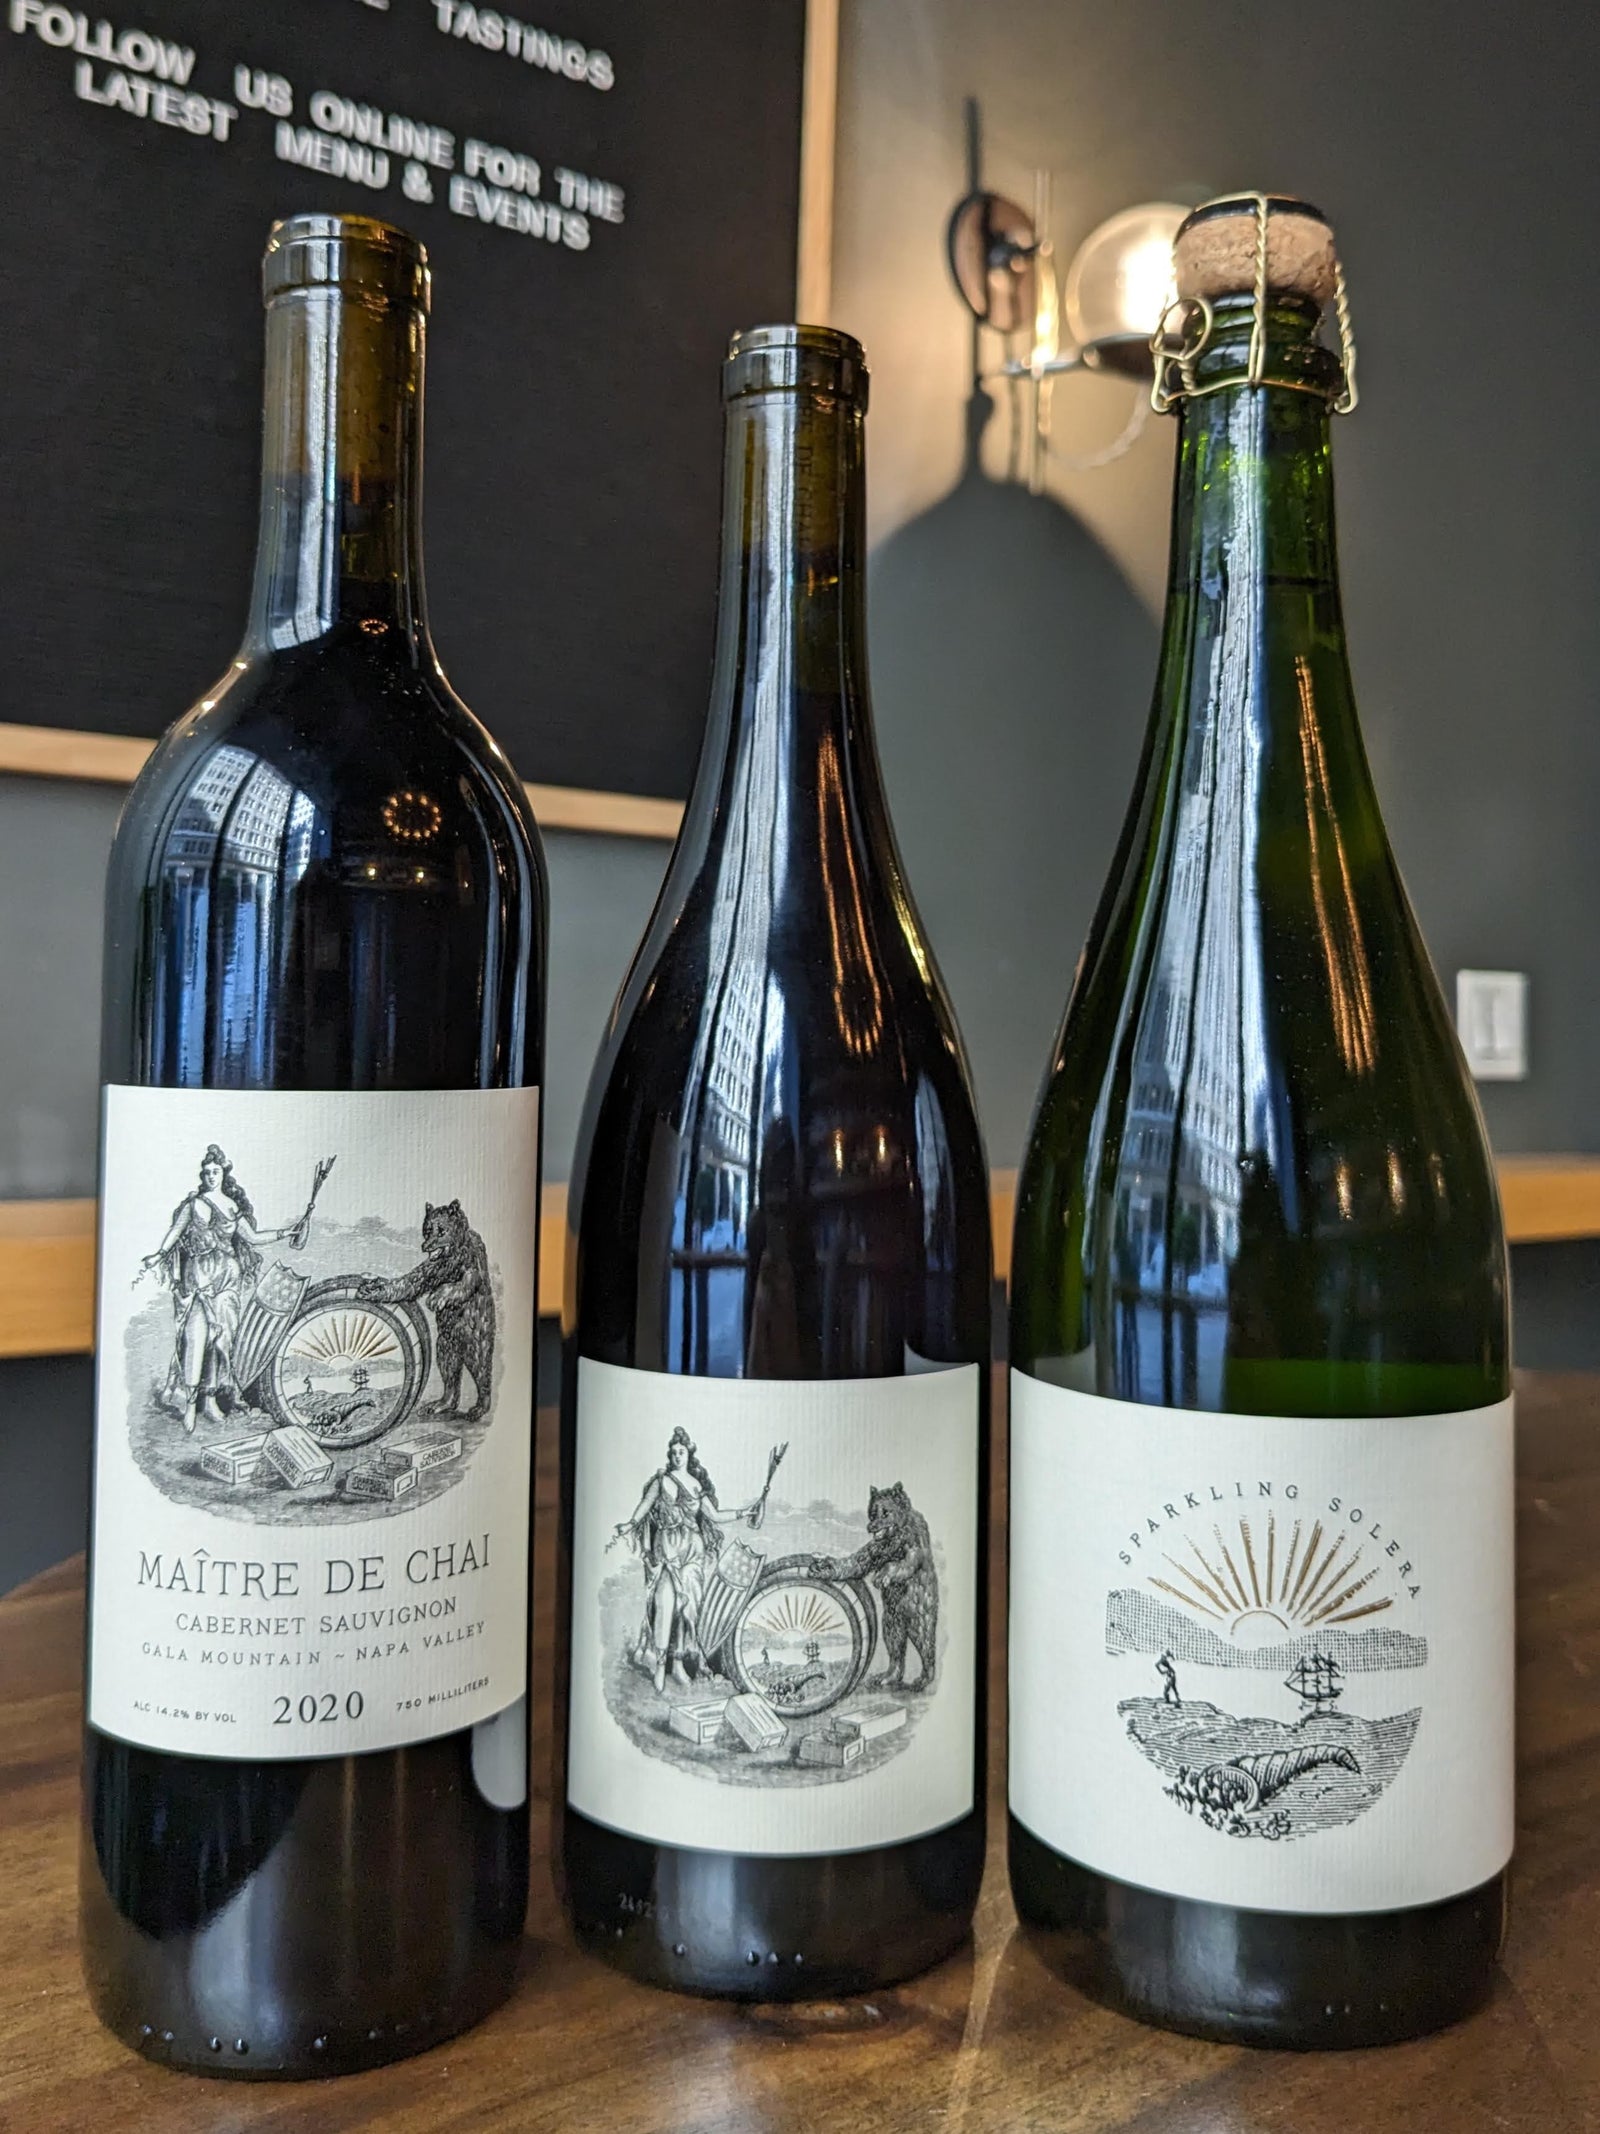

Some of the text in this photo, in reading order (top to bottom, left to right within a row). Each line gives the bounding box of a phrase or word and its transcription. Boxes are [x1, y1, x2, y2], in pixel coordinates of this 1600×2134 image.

[432, 0, 616, 91] TASTINGS
[9, 0, 625, 224] FOLLOW US ONLINE FOR THE
[75, 58, 591, 251] LATEST MENU & EVENTS
[137, 1533, 491, 1600] MAÎTRE DE CHAI
[1119, 1481, 1421, 1598] SPARKLING SOLERA
[142, 1641, 188, 1661] GALA
[201, 1649, 321, 1666] MOUNTAIN
[356, 1639, 410, 1661] NAPA
[422, 1620, 486, 1649] VALLEY
[176, 1596, 457, 1637] CABERNET SAUVIGNON
[133, 1700, 150, 1712] ALC
[195, 1711, 209, 1721] BY
[214, 1713, 237, 1723] VOL
[273, 1690, 365, 1725] 2020
[396, 1677, 489, 1711] 750 MILLILITERS
